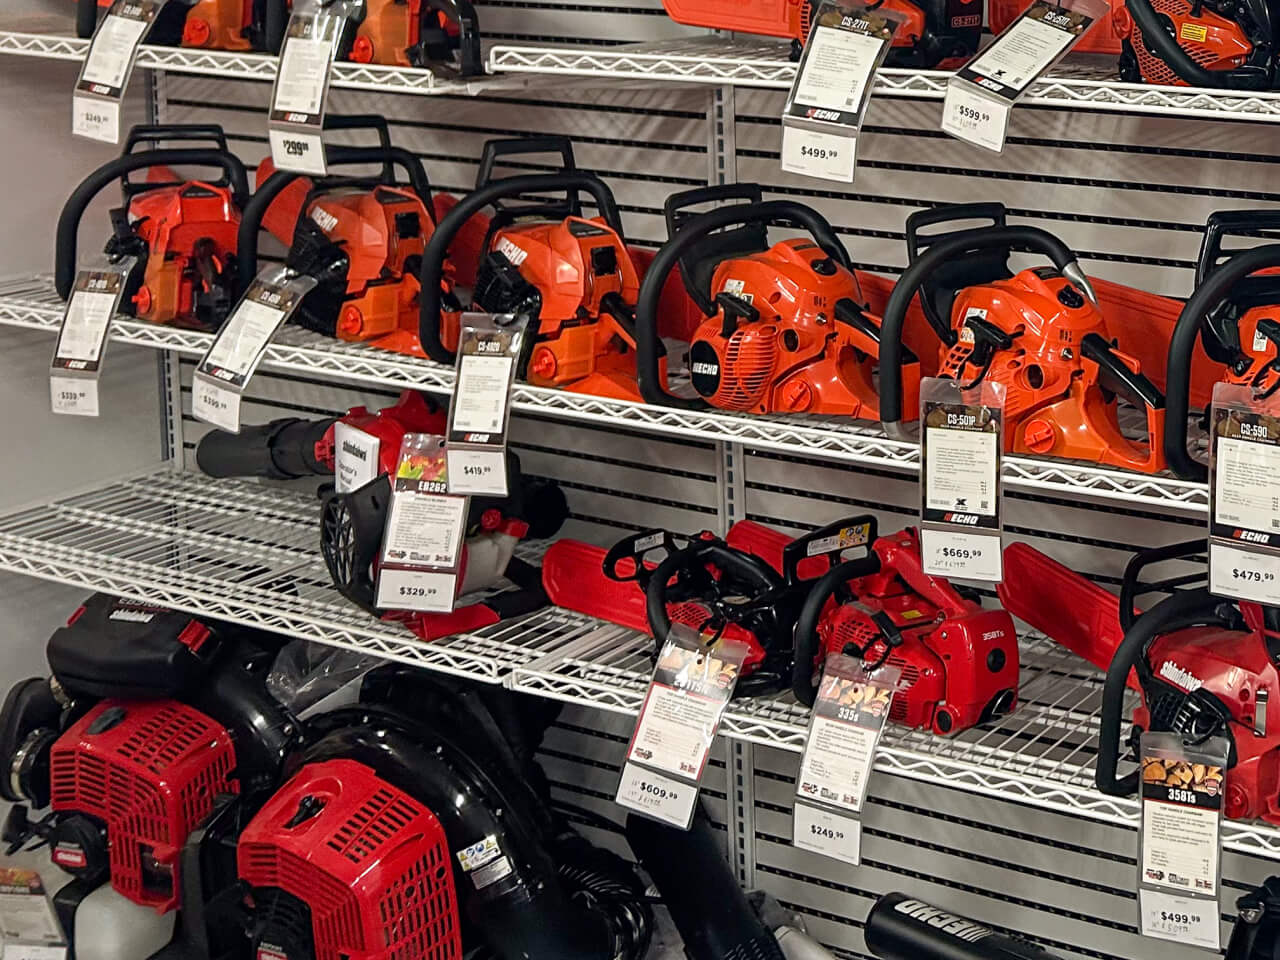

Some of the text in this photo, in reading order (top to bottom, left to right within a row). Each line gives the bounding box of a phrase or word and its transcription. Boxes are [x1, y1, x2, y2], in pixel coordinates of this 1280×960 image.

[813, 109, 840, 121] ECHO
[959, 105, 989, 122] $599.99
[801, 146, 838, 160] $499.99
[698, 364, 718, 375] ECHO
[947, 414, 976, 426] CS-501P
[1241, 423, 1267, 437] CS-590
[464, 466, 491, 476] $419.99
[951, 513, 978, 524] ECHO
[1240, 530, 1269, 543] ECHO
[942, 548, 981, 559] $669.99
[1232, 568, 1274, 583] $479.99
[400, 586, 436, 597] $329.99
[837, 707, 859, 722] 335s
[639, 782, 678, 799] $609.99
[1168, 789, 1196, 804] 358Ts
[810, 824, 844, 839] $249.99
[895, 898, 966, 933] ECHO
[1161, 911, 1200, 925] $499.99
